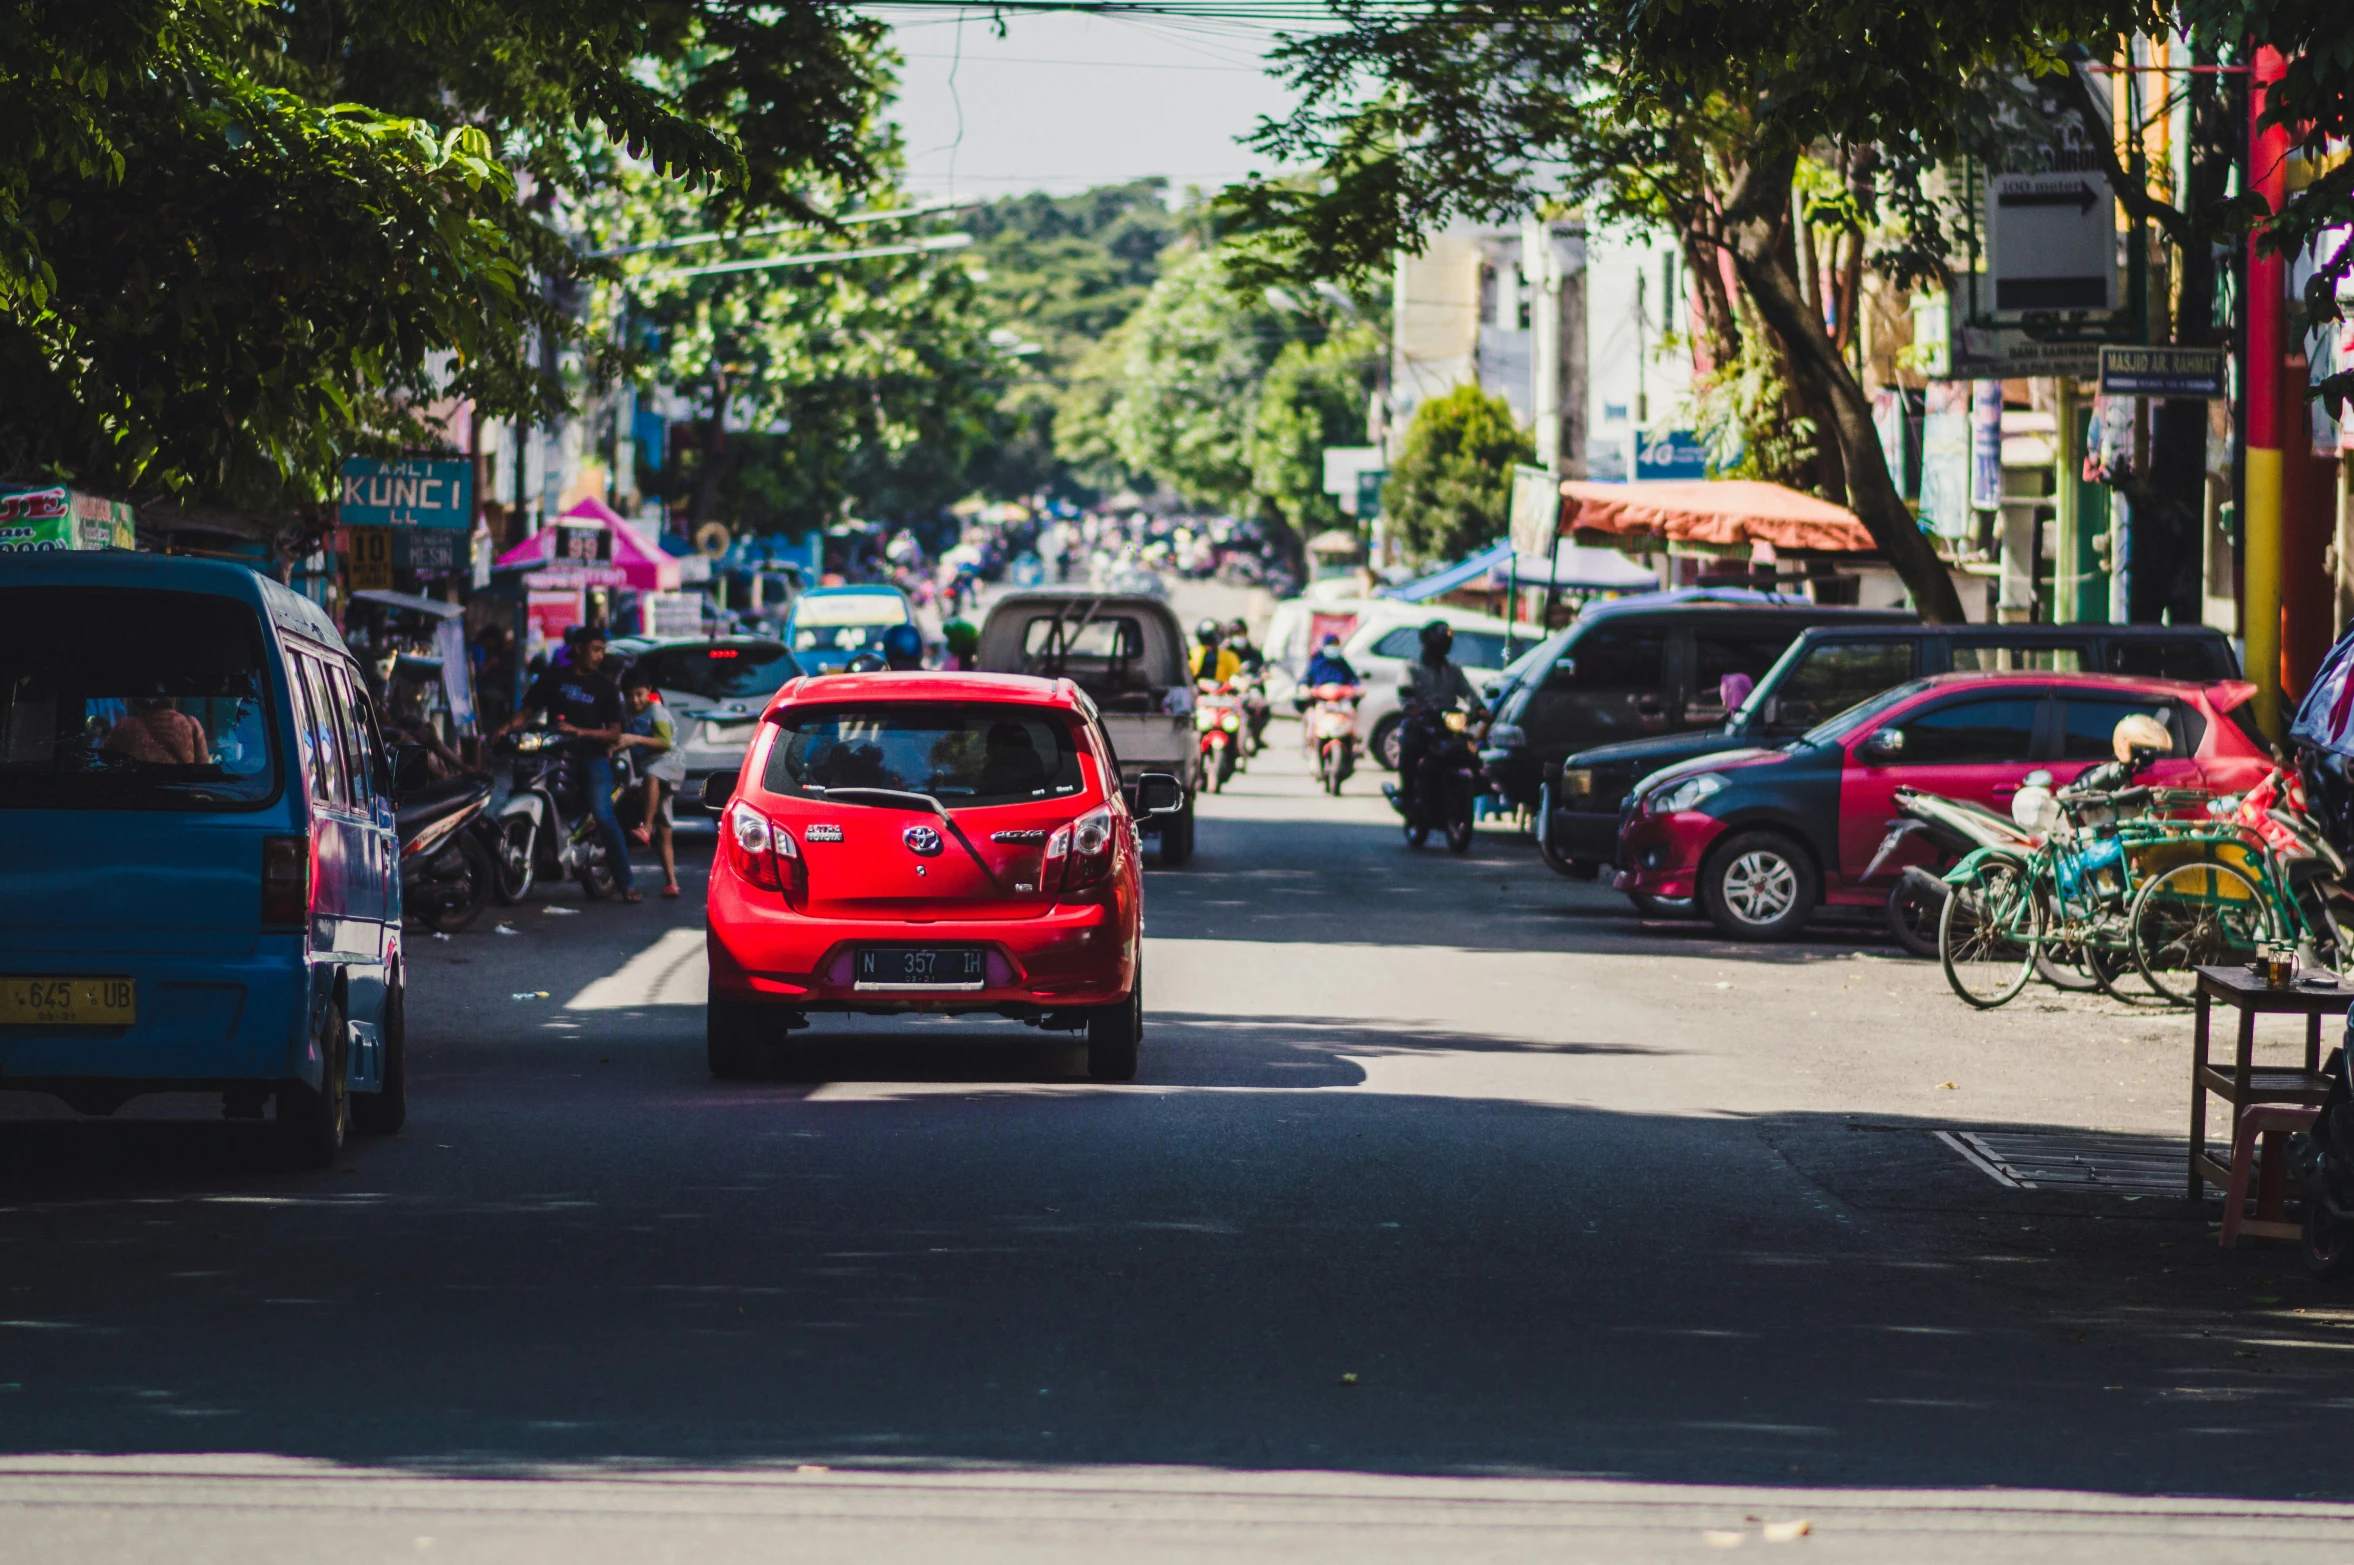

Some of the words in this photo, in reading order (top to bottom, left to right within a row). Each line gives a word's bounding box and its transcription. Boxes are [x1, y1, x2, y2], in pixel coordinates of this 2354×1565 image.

[2108, 352, 2148, 373] MASJID
[2173, 355, 2218, 374] RAHMAT
[343, 476, 461, 509] KUNCI
[354, 534, 386, 562] 10
[409, 546, 453, 566] MESIN
[568, 537, 599, 558] 99
[808, 833, 843, 842] TOYOTA
[863, 952, 875, 973] N
[904, 952, 936, 973] 357
[963, 952, 981, 973] IH
[30, 982, 71, 1008] 645
[103, 982, 131, 1008] UB
